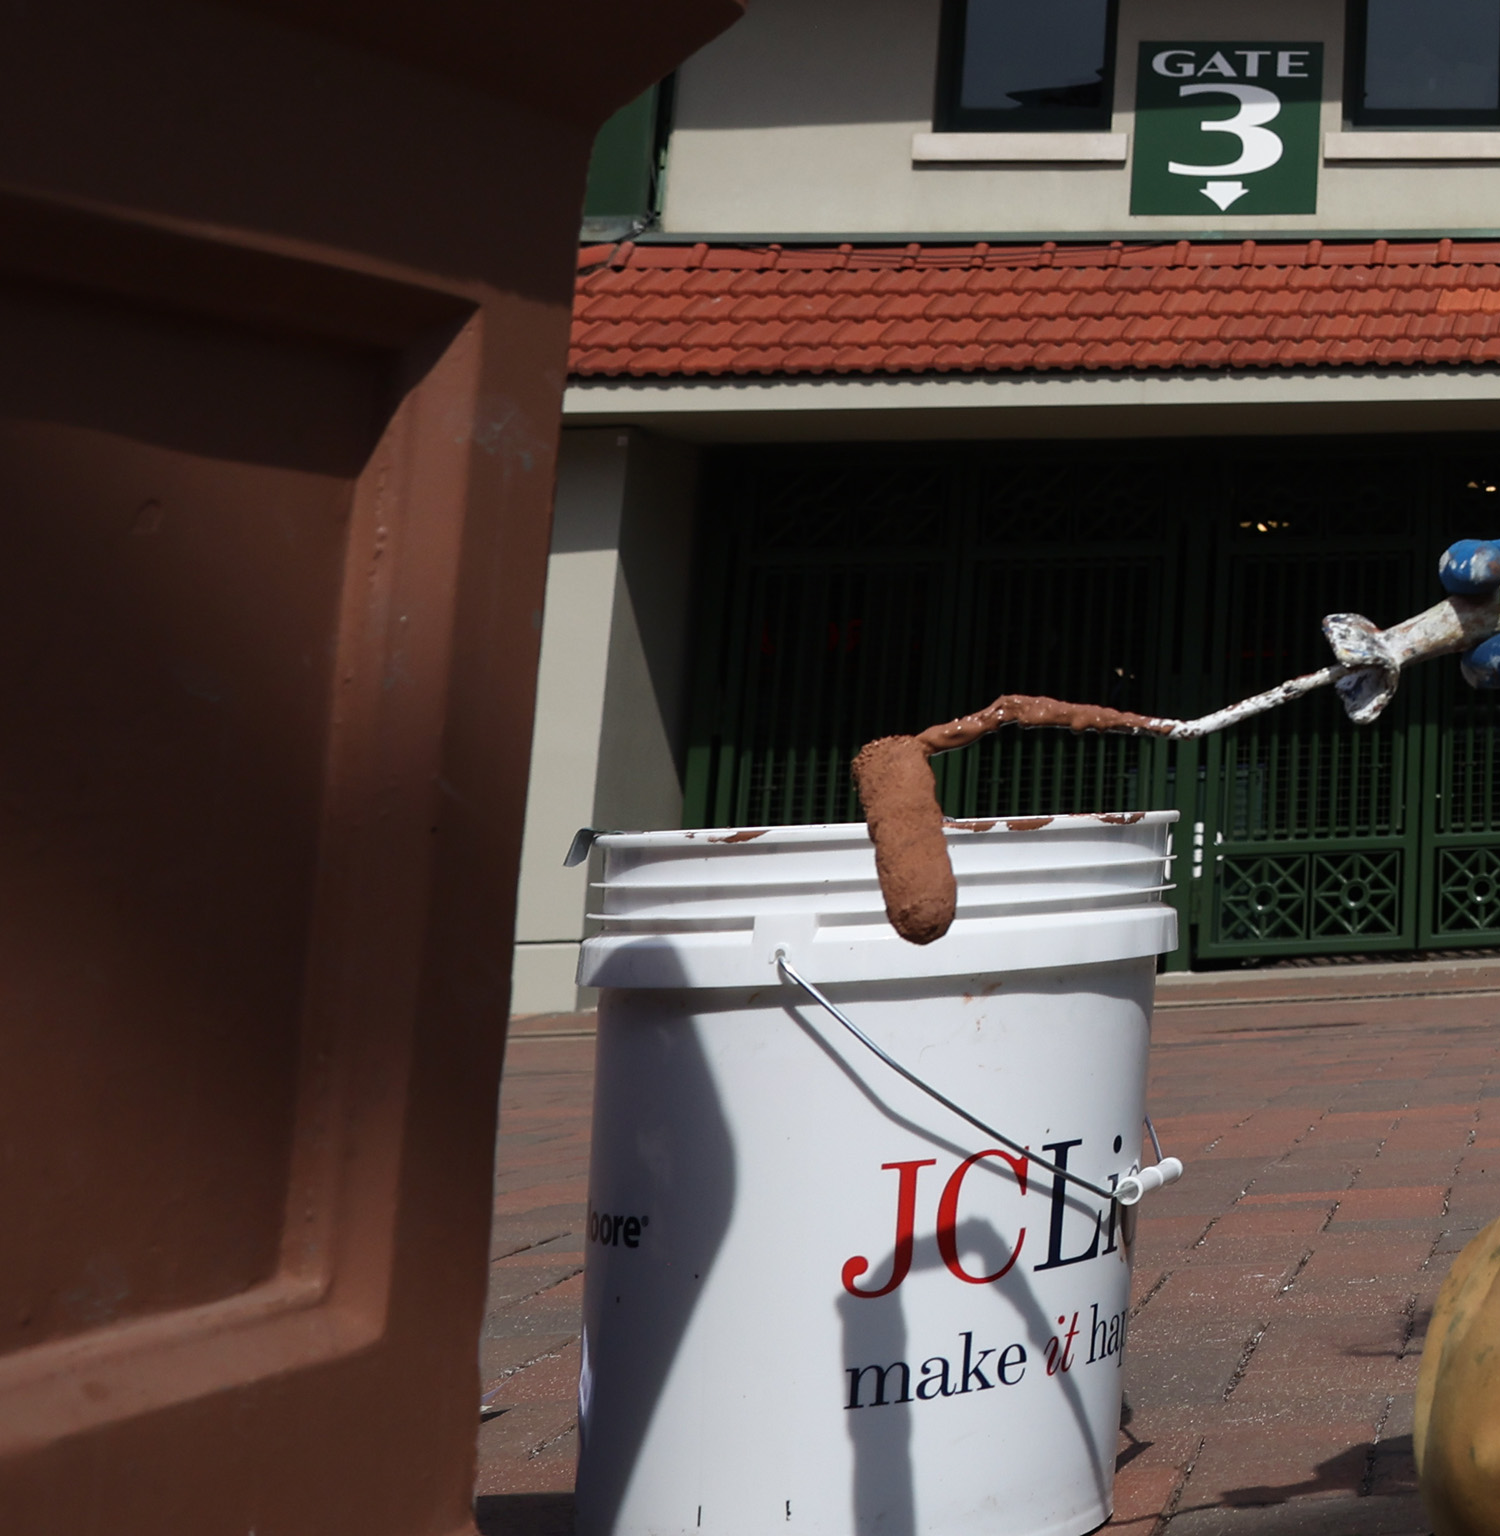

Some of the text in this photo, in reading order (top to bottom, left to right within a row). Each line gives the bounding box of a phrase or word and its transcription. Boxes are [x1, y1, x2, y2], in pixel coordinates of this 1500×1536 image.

[1152, 50, 1310, 78] GATE
[1168, 83, 1284, 177] 3
[843, 1332, 1028, 1409] make
[1044, 1312, 1080, 1377] it
